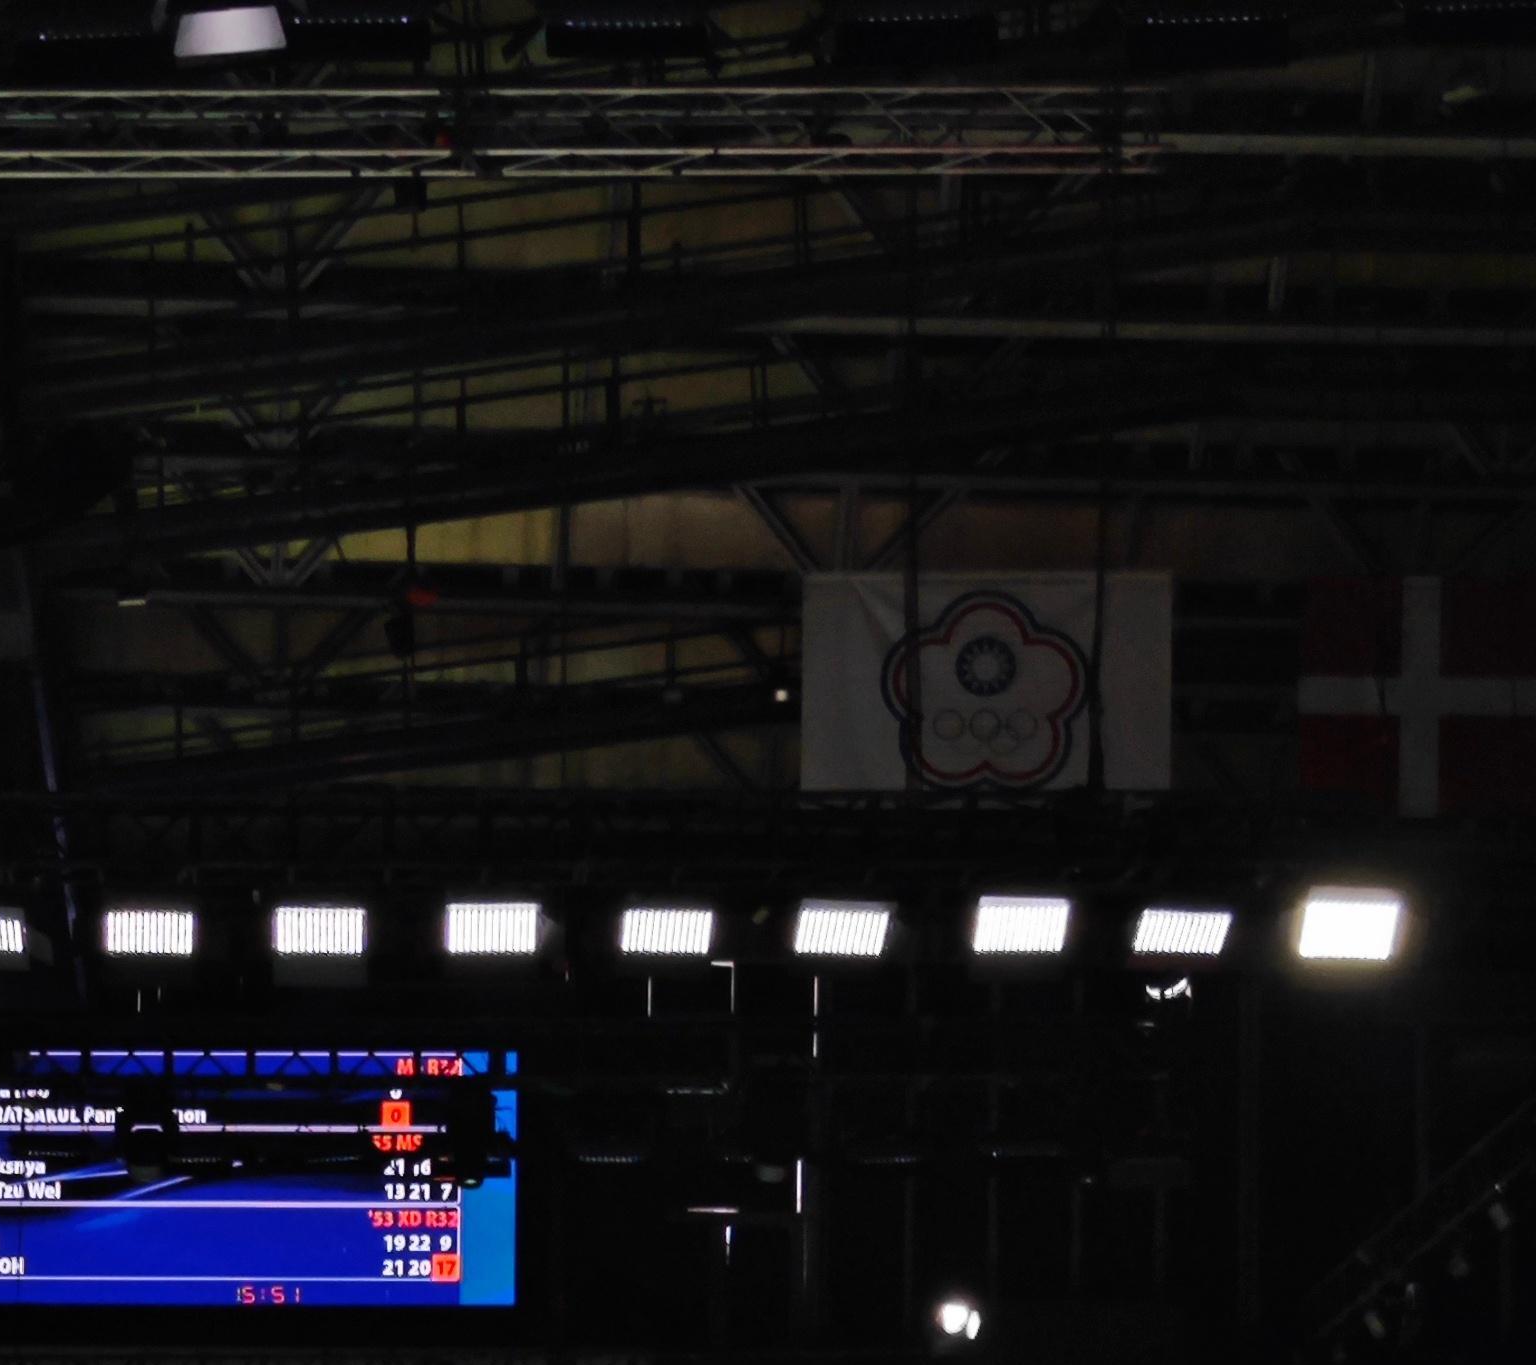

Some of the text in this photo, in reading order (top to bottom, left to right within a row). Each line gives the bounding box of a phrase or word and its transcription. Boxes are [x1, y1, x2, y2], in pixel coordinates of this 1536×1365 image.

[384, 1183, 405, 1200] 13
[409, 1183, 431, 1200] 21
[440, 1184, 452, 1201] 7
[398, 1210, 421, 1228] XD
[425, 1210, 458, 1228] R32
[383, 1235, 405, 1252] 19
[409, 1235, 431, 1252] 22
[440, 1235, 452, 1252] 9
[382, 1259, 405, 1277] 21
[408, 1259, 431, 1277] 20
[436, 1259, 456, 1276] 17
